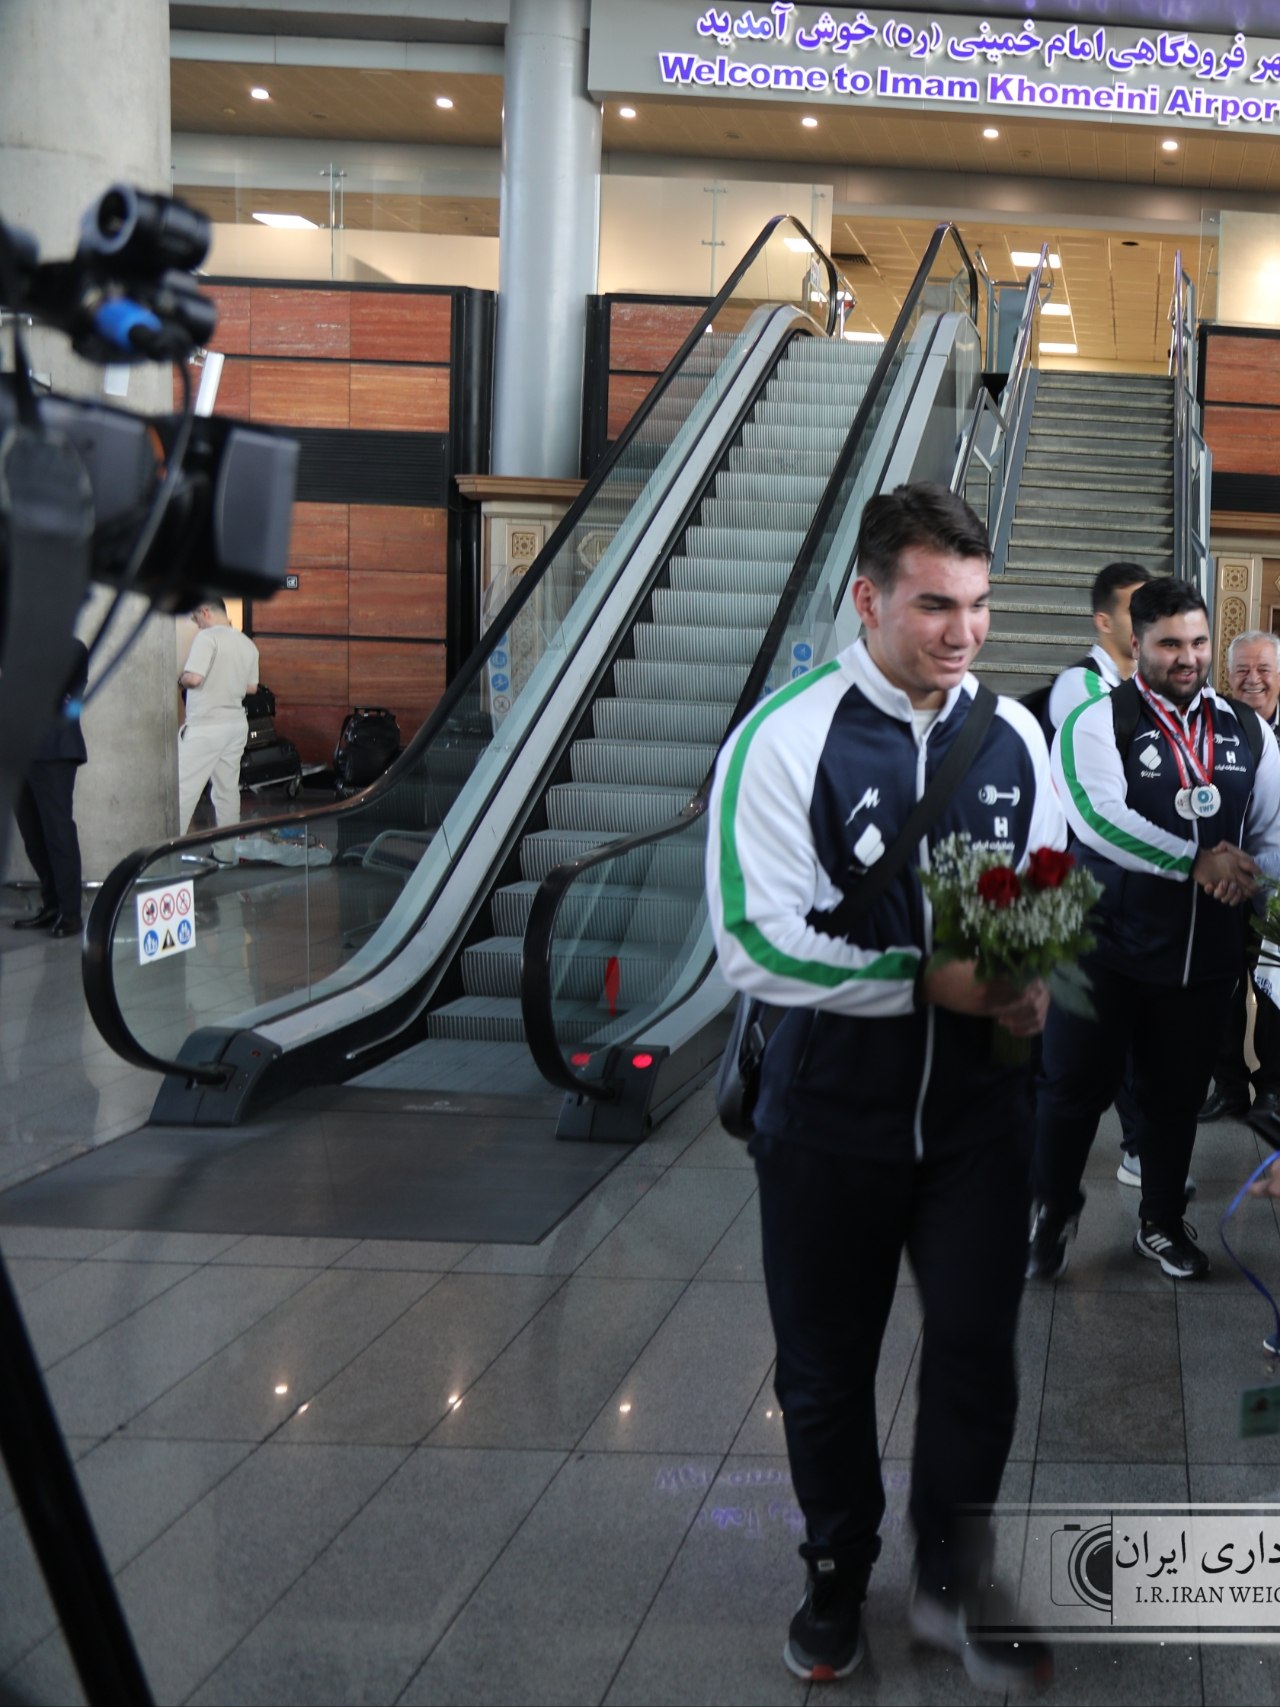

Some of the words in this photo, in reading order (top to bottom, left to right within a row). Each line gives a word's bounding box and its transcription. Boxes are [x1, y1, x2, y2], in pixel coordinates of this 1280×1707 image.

[696, 1, 794, 45] آمدید
[796, 12, 878, 51] خوش
[882, 19, 942, 57] (ره)
[948, 19, 1042, 63] خمینی
[1045, 26, 1104, 66] امام
[1107, 33, 1247, 79] فرودگاهی
[659, 52, 828, 90] Welcome
[833, 65, 872, 93] to
[877, 66, 980, 102] Imam
[987, 73, 1160, 114] Khomeini
